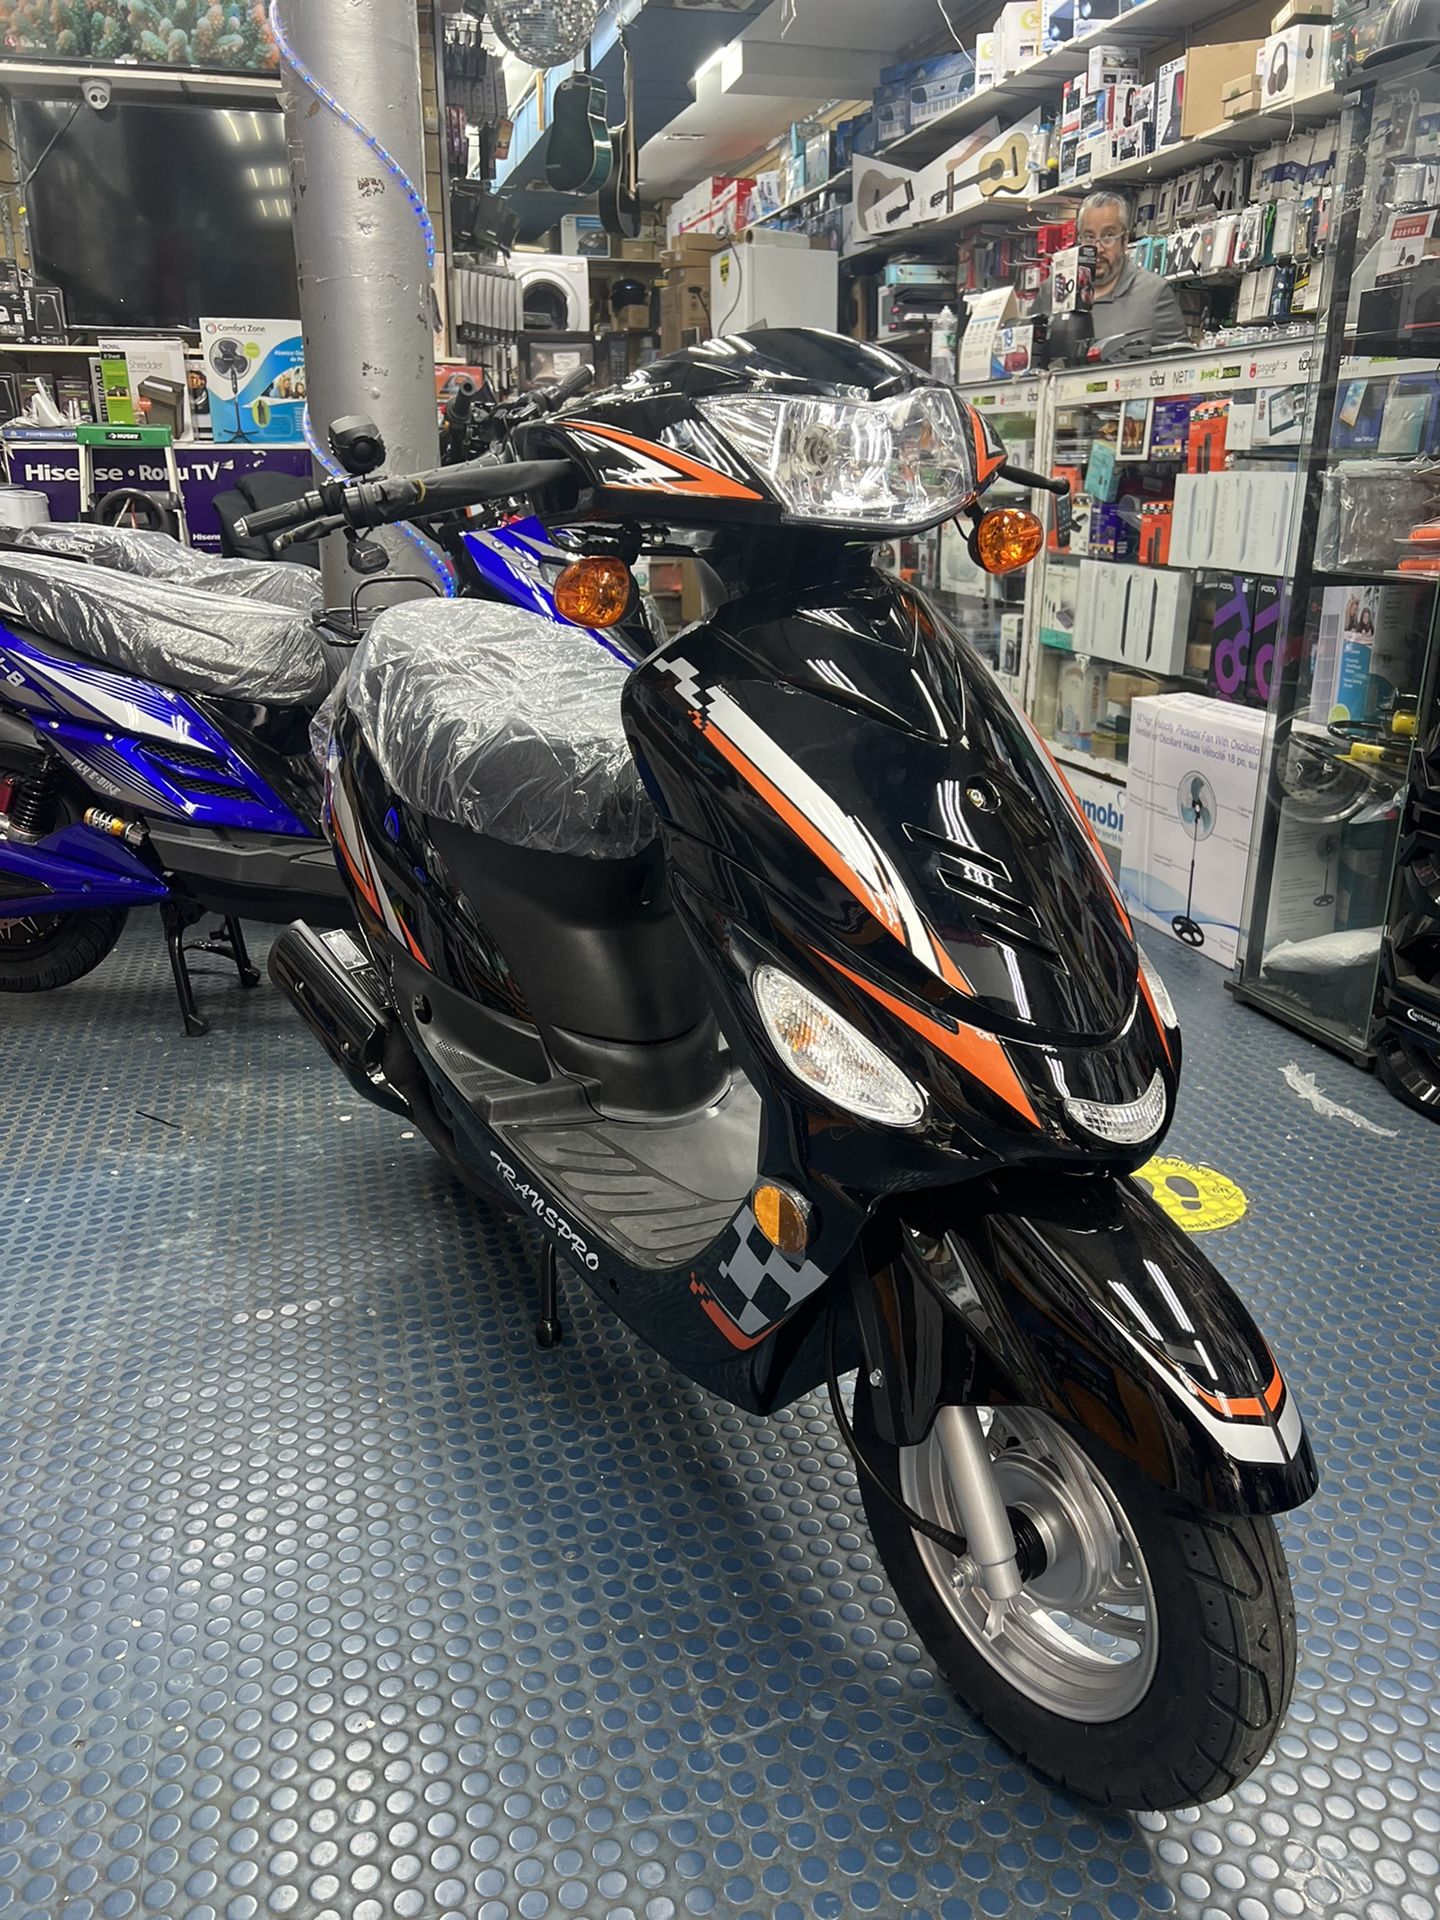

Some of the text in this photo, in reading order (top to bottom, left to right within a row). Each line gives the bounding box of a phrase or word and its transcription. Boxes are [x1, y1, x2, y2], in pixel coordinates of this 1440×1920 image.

[217, 324, 266, 333] Comfort Zone
[128, 360, 163, 370] Shredder
[116, 432, 139, 440] HUSKY
[25, 463, 124, 482] Hisese
[191, 460, 220, 481] TV
[1159, 732, 1183, 749] Oscillant
[1182, 740, 1201, 755] Haute
[1227, 751, 1236, 764] 18
[1201, 730, 1214, 743] Fan
[1215, 735, 1230, 749] With
[1230, 738, 1261, 757] Oscillatio
[71, 758, 91, 777] FLY
[490, 1150, 599, 1271] TRANSPRO
